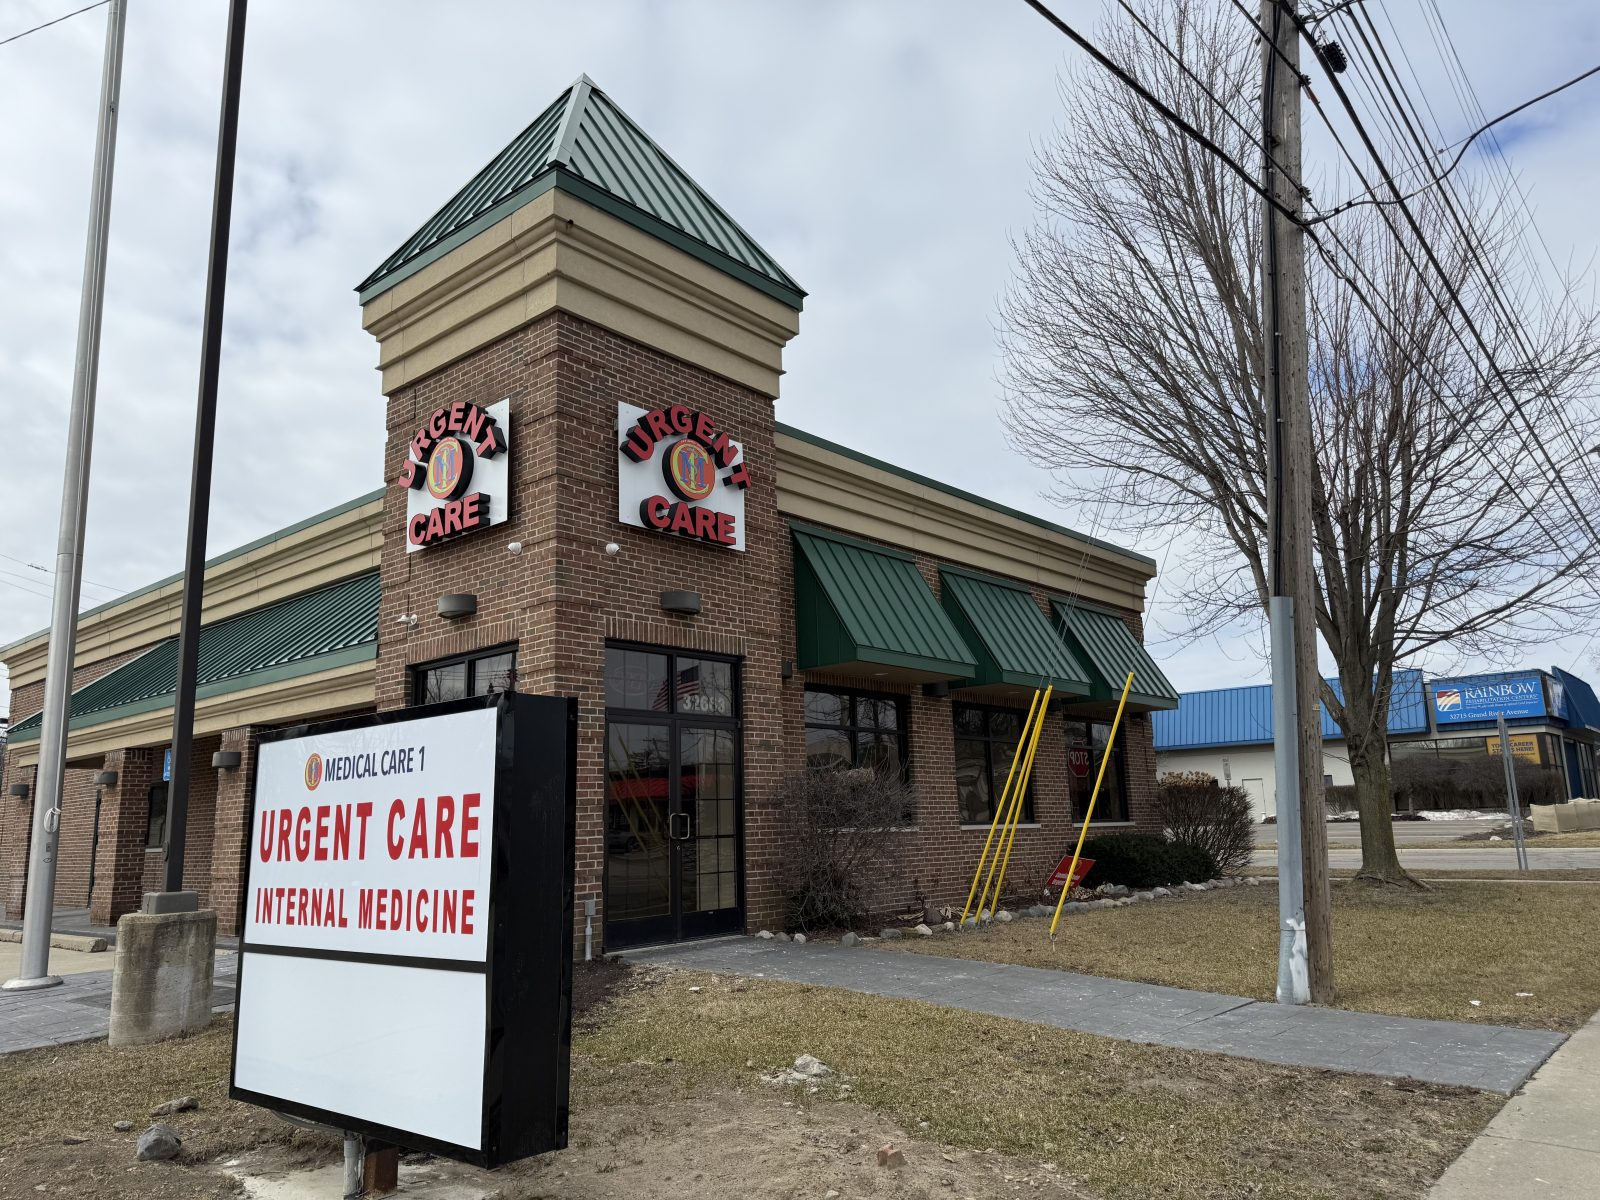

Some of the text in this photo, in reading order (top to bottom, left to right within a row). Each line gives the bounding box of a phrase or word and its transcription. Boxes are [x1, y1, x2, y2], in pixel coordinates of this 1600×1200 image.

[399, 402, 498, 489] URGENT
[623, 404, 750, 490] URGENT
[408, 492, 481, 546] CARE
[648, 494, 737, 546] CARE
[1465, 681, 1536, 699] RAINBOW
[324, 745, 425, 783] MEDICAL CARE 1
[260, 793, 481, 863] URGENT CARE
[255, 887, 475, 935] INTERNAL MEDICINE
